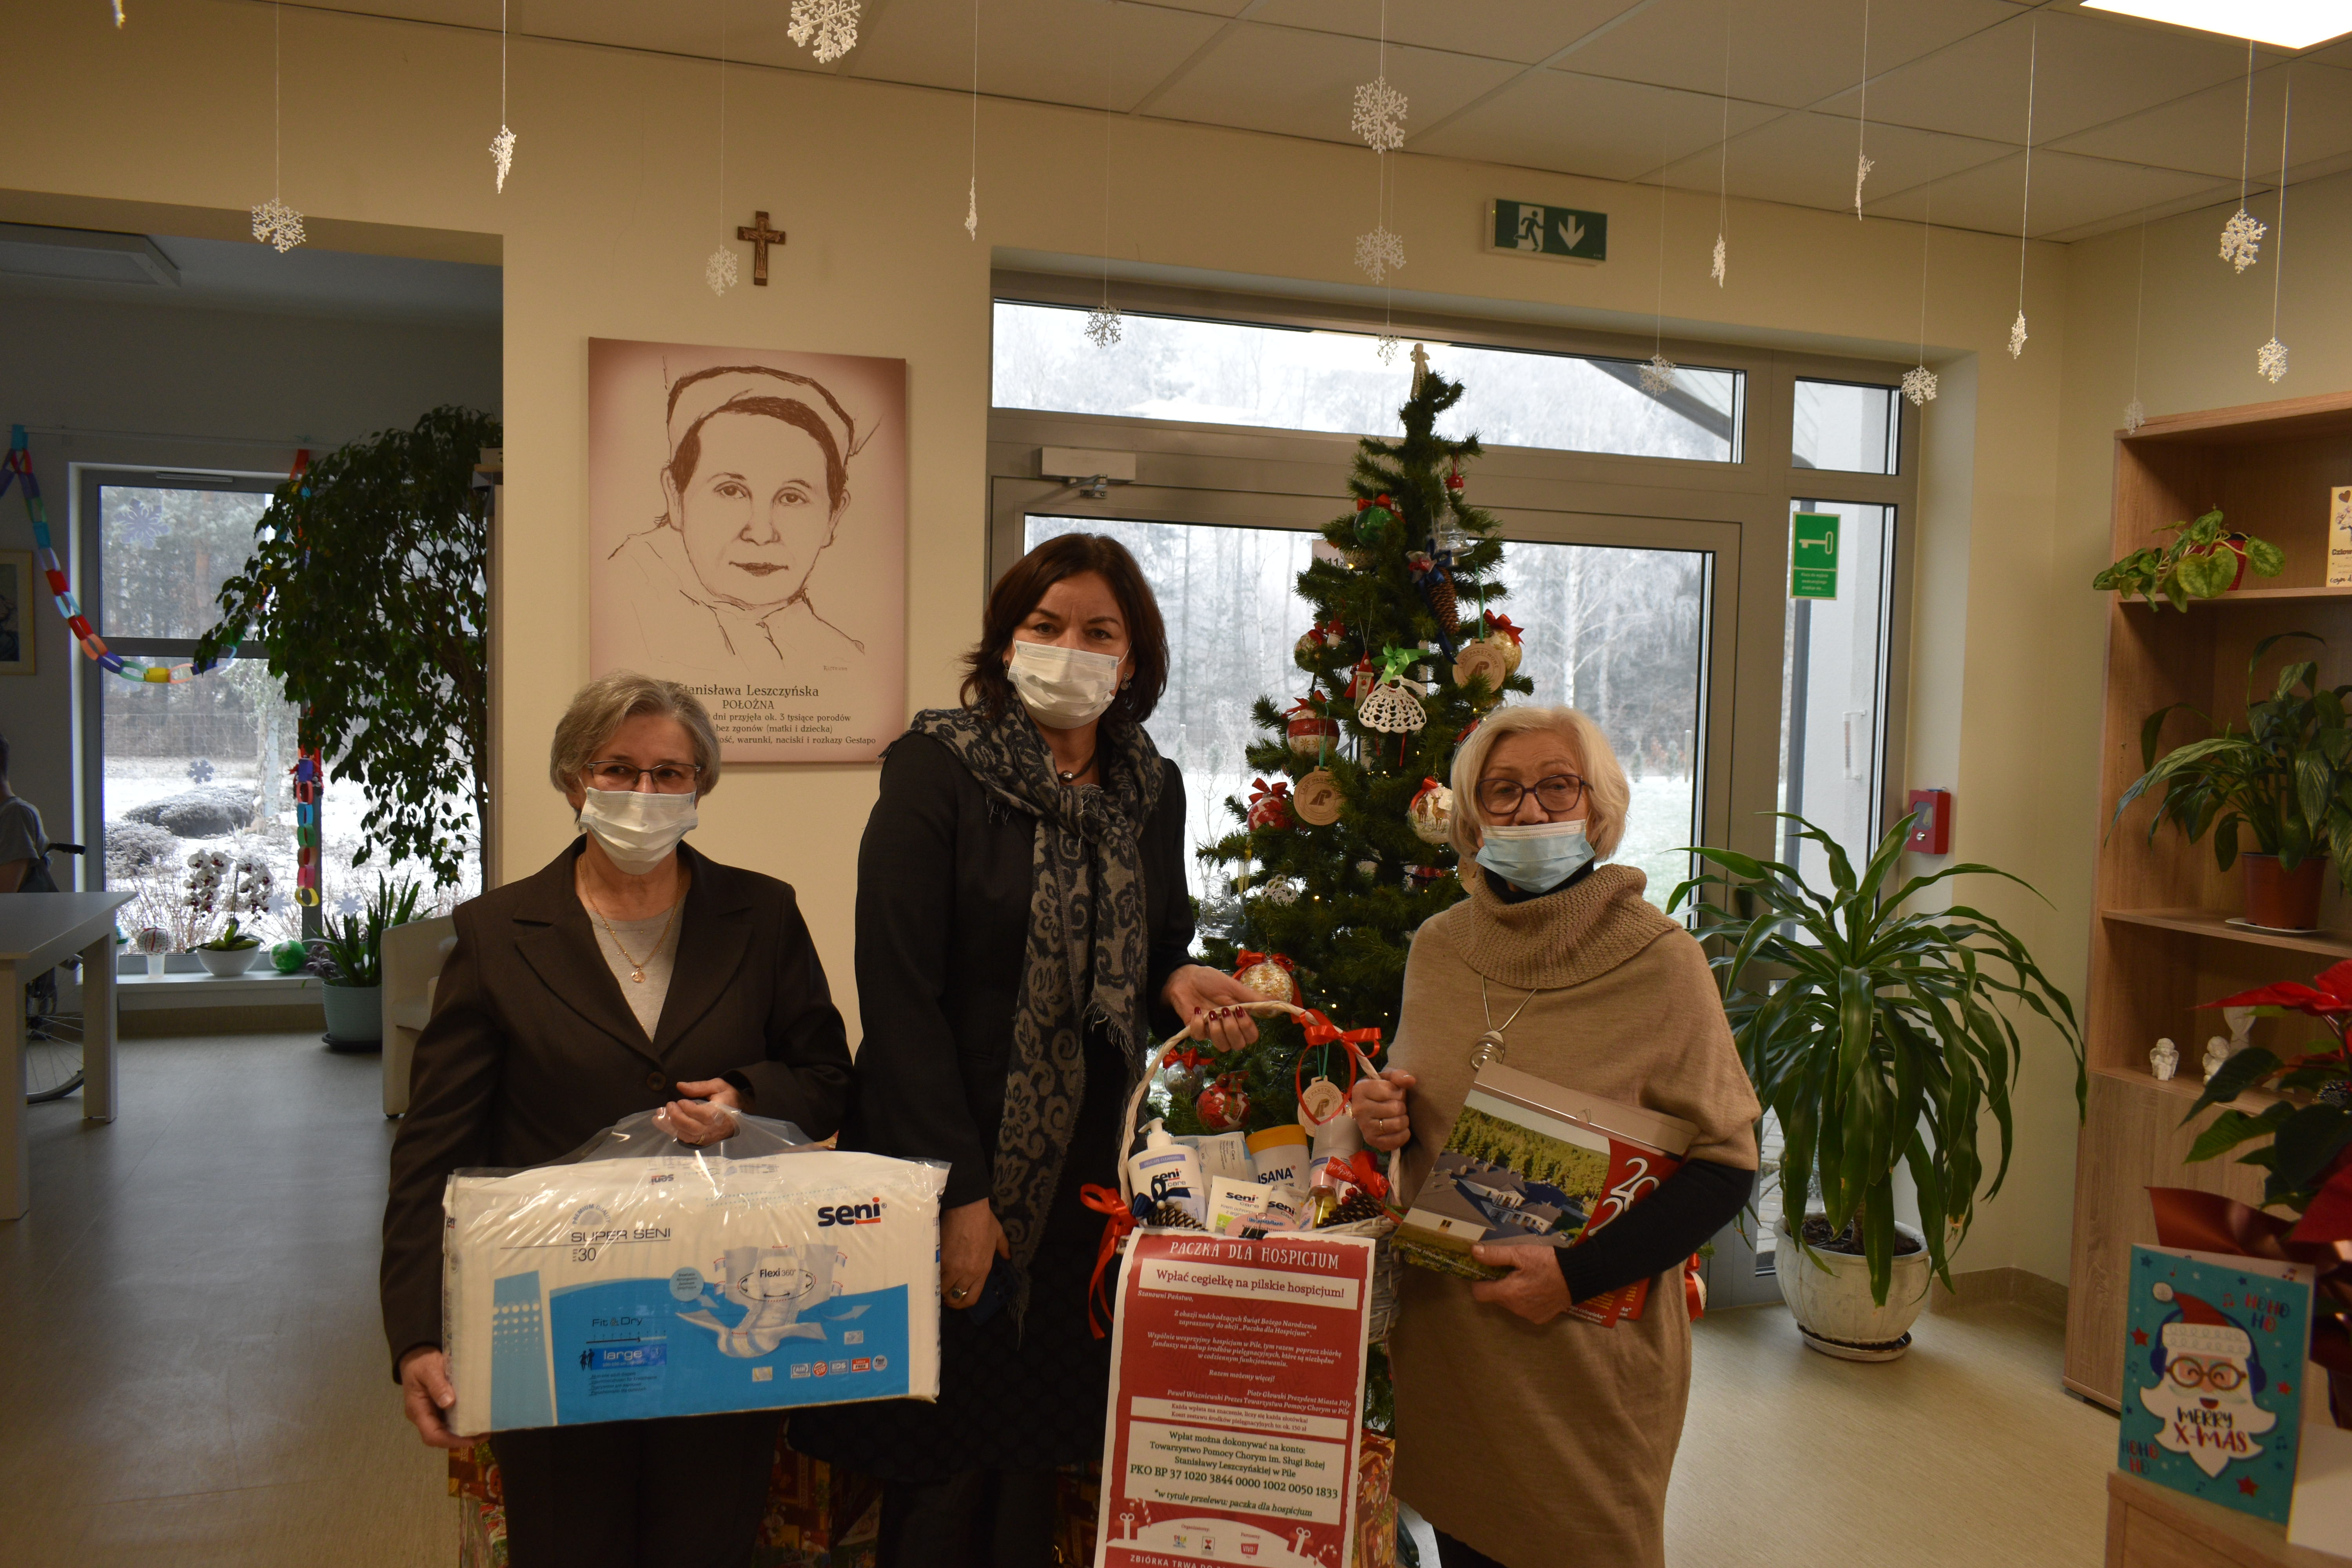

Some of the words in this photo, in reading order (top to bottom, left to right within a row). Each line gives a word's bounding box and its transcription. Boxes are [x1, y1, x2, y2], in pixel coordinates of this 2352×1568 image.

[680, 684, 741, 695] tanisława
[747, 685, 818, 698] Leszczyńska
[722, 699, 775, 709] POŁOŻNA
[730, 713, 761, 722] przyjęła
[788, 714, 814, 722] tysiące
[817, 714, 851, 722] porodów
[732, 724, 763, 733] zgonów
[766, 724, 792, 733] (matki
[800, 725, 833, 734] dziecka)
[846, 736, 876, 745] Gestapo
[1258, 1167, 1294, 1184] ISANA
[572, 1204, 594, 1225] PREMIUM
[595, 1205, 612, 1223] QUALITY
[571, 1229, 627, 1243] SUPER
[633, 1227, 671, 1240] SENI
[578, 1247, 597, 1261] 30
[1169, 1242, 1220, 1257] PACZKA
[1228, 1244, 1252, 1261] DLA
[1261, 1247, 1339, 1270] HOSPICJUM
[760, 1268, 780, 1278] Flexi
[1156, 1269, 1189, 1283] Wpłać
[1191, 1274, 1233, 1289] cegiełkę
[1236, 1279, 1249, 1288] na
[1251, 1279, 1285, 1291] pilskie
[1287, 1281, 1345, 1298] hospicjum!
[1138, 1290, 1167, 1299] Szanowni
[1167, 1292, 1194, 1302] Państwo,
[592, 1318, 608, 1327] Fit
[610, 1317, 619, 1326] &
[621, 1317, 643, 1326] Dry
[1179, 1310, 1198, 1319] okazji
[1198, 1313, 1242, 1323] nadchodzących
[1243, 1316, 1260, 1324] Świąt
[1261, 1318, 1282, 1327] Bożego
[1283, 1320, 1317, 1330] Narodzenia
[1179, 1319, 1215, 1329] zapraszamy
[1147, 1331, 1175, 1340] Wspólnie
[1176, 1335, 1211, 1344] wesprzyjmy
[1212, 1337, 1243, 1347] hospicjum
[1320, 1349, 1342, 1358] zbiórkę
[603, 1350, 643, 1361] large
[1151, 1340, 1179, 1350] funduszy
[1188, 1343, 1206, 1352] zakup
[1207, 1345, 1232, 1353] środków
[1281, 1352, 1297, 1360] które
[1305, 1356, 1334, 1365] niezbędne
[1204, 1353, 1238, 1363] codziennym
[1238, 1357, 1288, 1367] funkcjonowaniu.
[1230, 1372, 1254, 1381] możemy
[1255, 1374, 1275, 1383] więcej!
[1186, 1390, 1223, 1401] Wiszniewski
[1223, 1395, 1243, 1403] Prezes
[1243, 1397, 1283, 1408] Towarzystwa
[1283, 1401, 1307, 1411] Pomocy
[1307, 1404, 1331, 1414] Chorym
[1338, 1407, 1350, 1416] Pile
[1262, 1391, 1287, 1400] Głowski
[1287, 1394, 1317, 1403] Prezydent
[1317, 1397, 1338, 1406] Miasta
[1208, 1415, 1231, 1423] środków
[2177, 1406, 2233, 1429] MERRY
[1169, 1431, 1193, 1441] Wpłat
[1194, 1435, 1221, 1444] można
[1222, 1437, 1267, 1450] dokonywać
[1280, 1443, 1306, 1454] konto:
[2174, 1421, 2249, 1453] X-MAS
[1150, 1441, 1201, 1454] Towarzystwo
[1203, 1447, 1234, 1459] Pomocy
[1235, 1451, 1267, 1463] Chorym
[1269, 1454, 1281, 1463] im.
[1283, 1456, 1303, 1467] Sługi
[1304, 1458, 1325, 1470] Bożej
[1174, 1456, 1217, 1469] Stanisławy
[1219, 1461, 1271, 1476] Leszczyńskiej
[1281, 1468, 1296, 1478] Pile
[1130, 1464, 1152, 1475] PKO
[1154, 1466, 1168, 1477] BP
[1170, 1469, 1181, 1480] 37
[1184, 1471, 1207, 1481] 1020
[1209, 1474, 1233, 1485] 3844
[1235, 1477, 1261, 1488] 0000
[1263, 1480, 1286, 1492] 1002
[1288, 1484, 1314, 1495] 0050
[1316, 1487, 1338, 1499] 1833
[1167, 1491, 1190, 1501] tytule
[1190, 1494, 1228, 1506] przelewu:
[1229, 1499, 1256, 1509] paczka
[1258, 1502, 1270, 1511] dla
[1272, 1503, 1313, 1517] hospicjum
[1130, 1554, 1169, 1567] ZBIÓRKA
